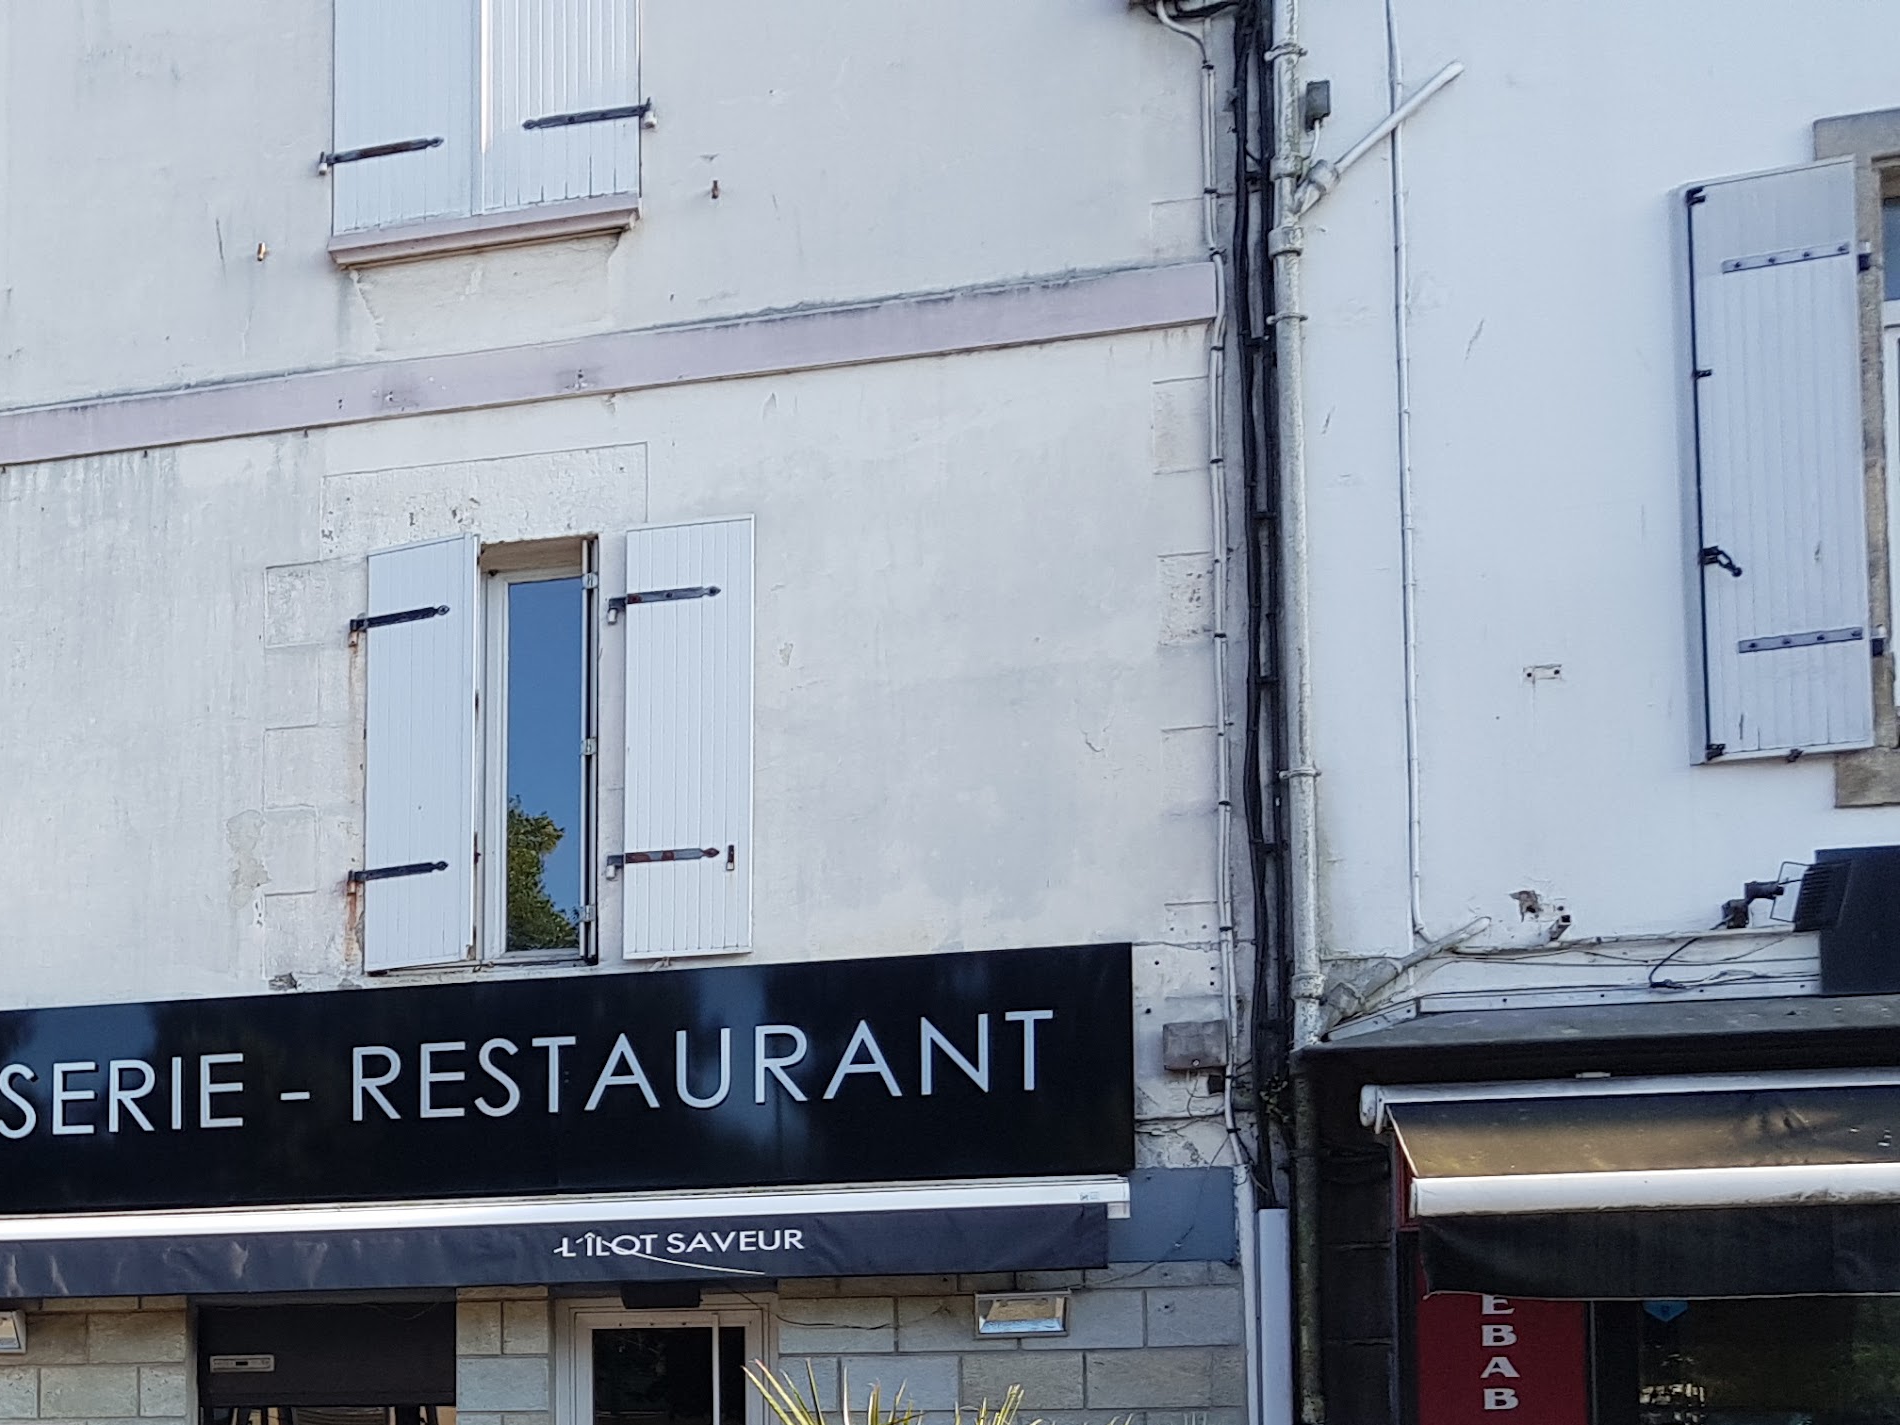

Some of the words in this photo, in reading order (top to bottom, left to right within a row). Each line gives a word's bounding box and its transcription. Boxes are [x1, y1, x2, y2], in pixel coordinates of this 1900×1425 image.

[352, 1008, 1056, 1123] RESTAURANT
[666, 1228, 805, 1255] SAVEUR
[1480, 1294, 1521, 1412] EBAB
